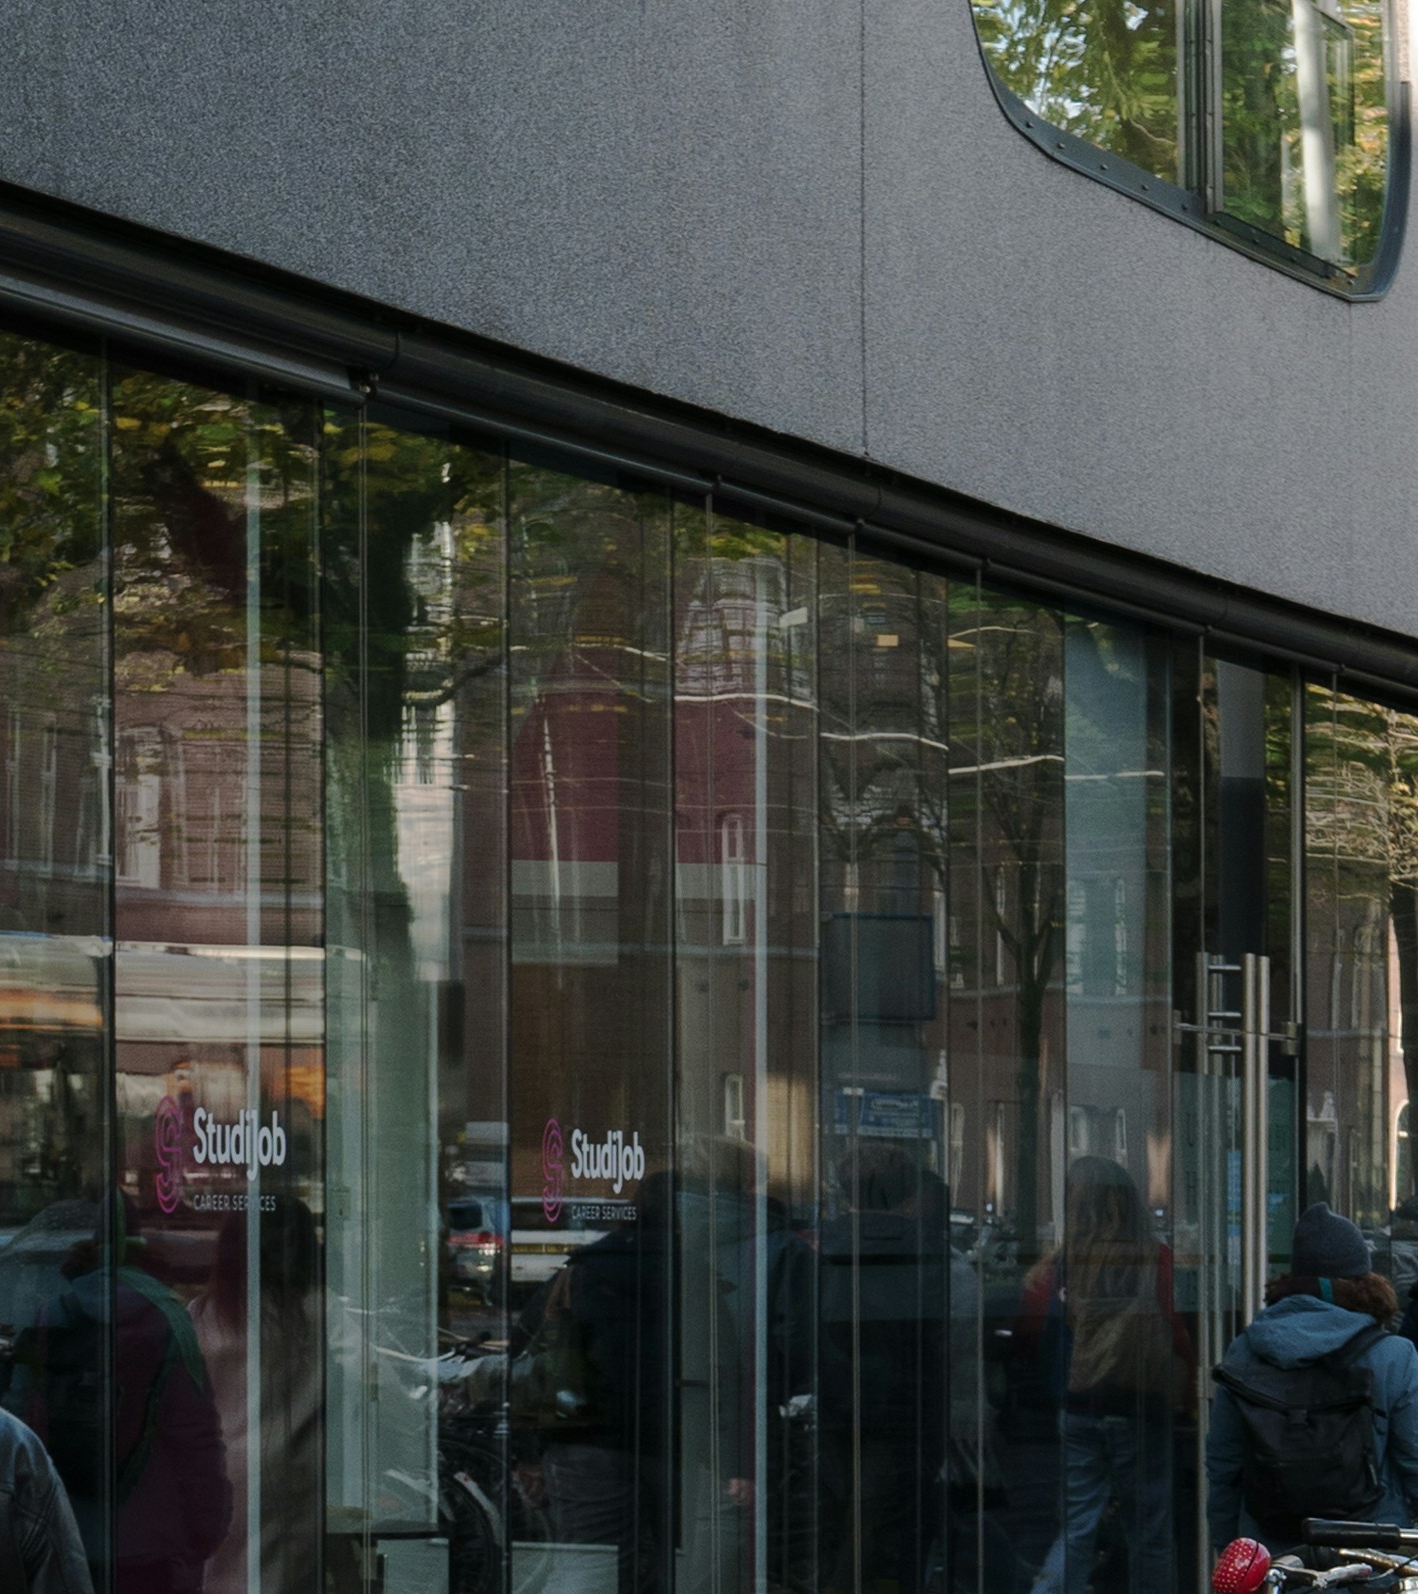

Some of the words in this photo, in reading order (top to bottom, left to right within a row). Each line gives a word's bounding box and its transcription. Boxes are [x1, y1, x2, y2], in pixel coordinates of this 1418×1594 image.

[192, 1107, 287, 1182] StudiJob
[570, 1128, 645, 1195] StudiJob
[193, 1194, 231, 1211] CAREER
[232, 1194, 277, 1212] SERCES
[571, 1205, 600, 1220] CAREER
[602, 1205, 638, 1221] SERVICES
